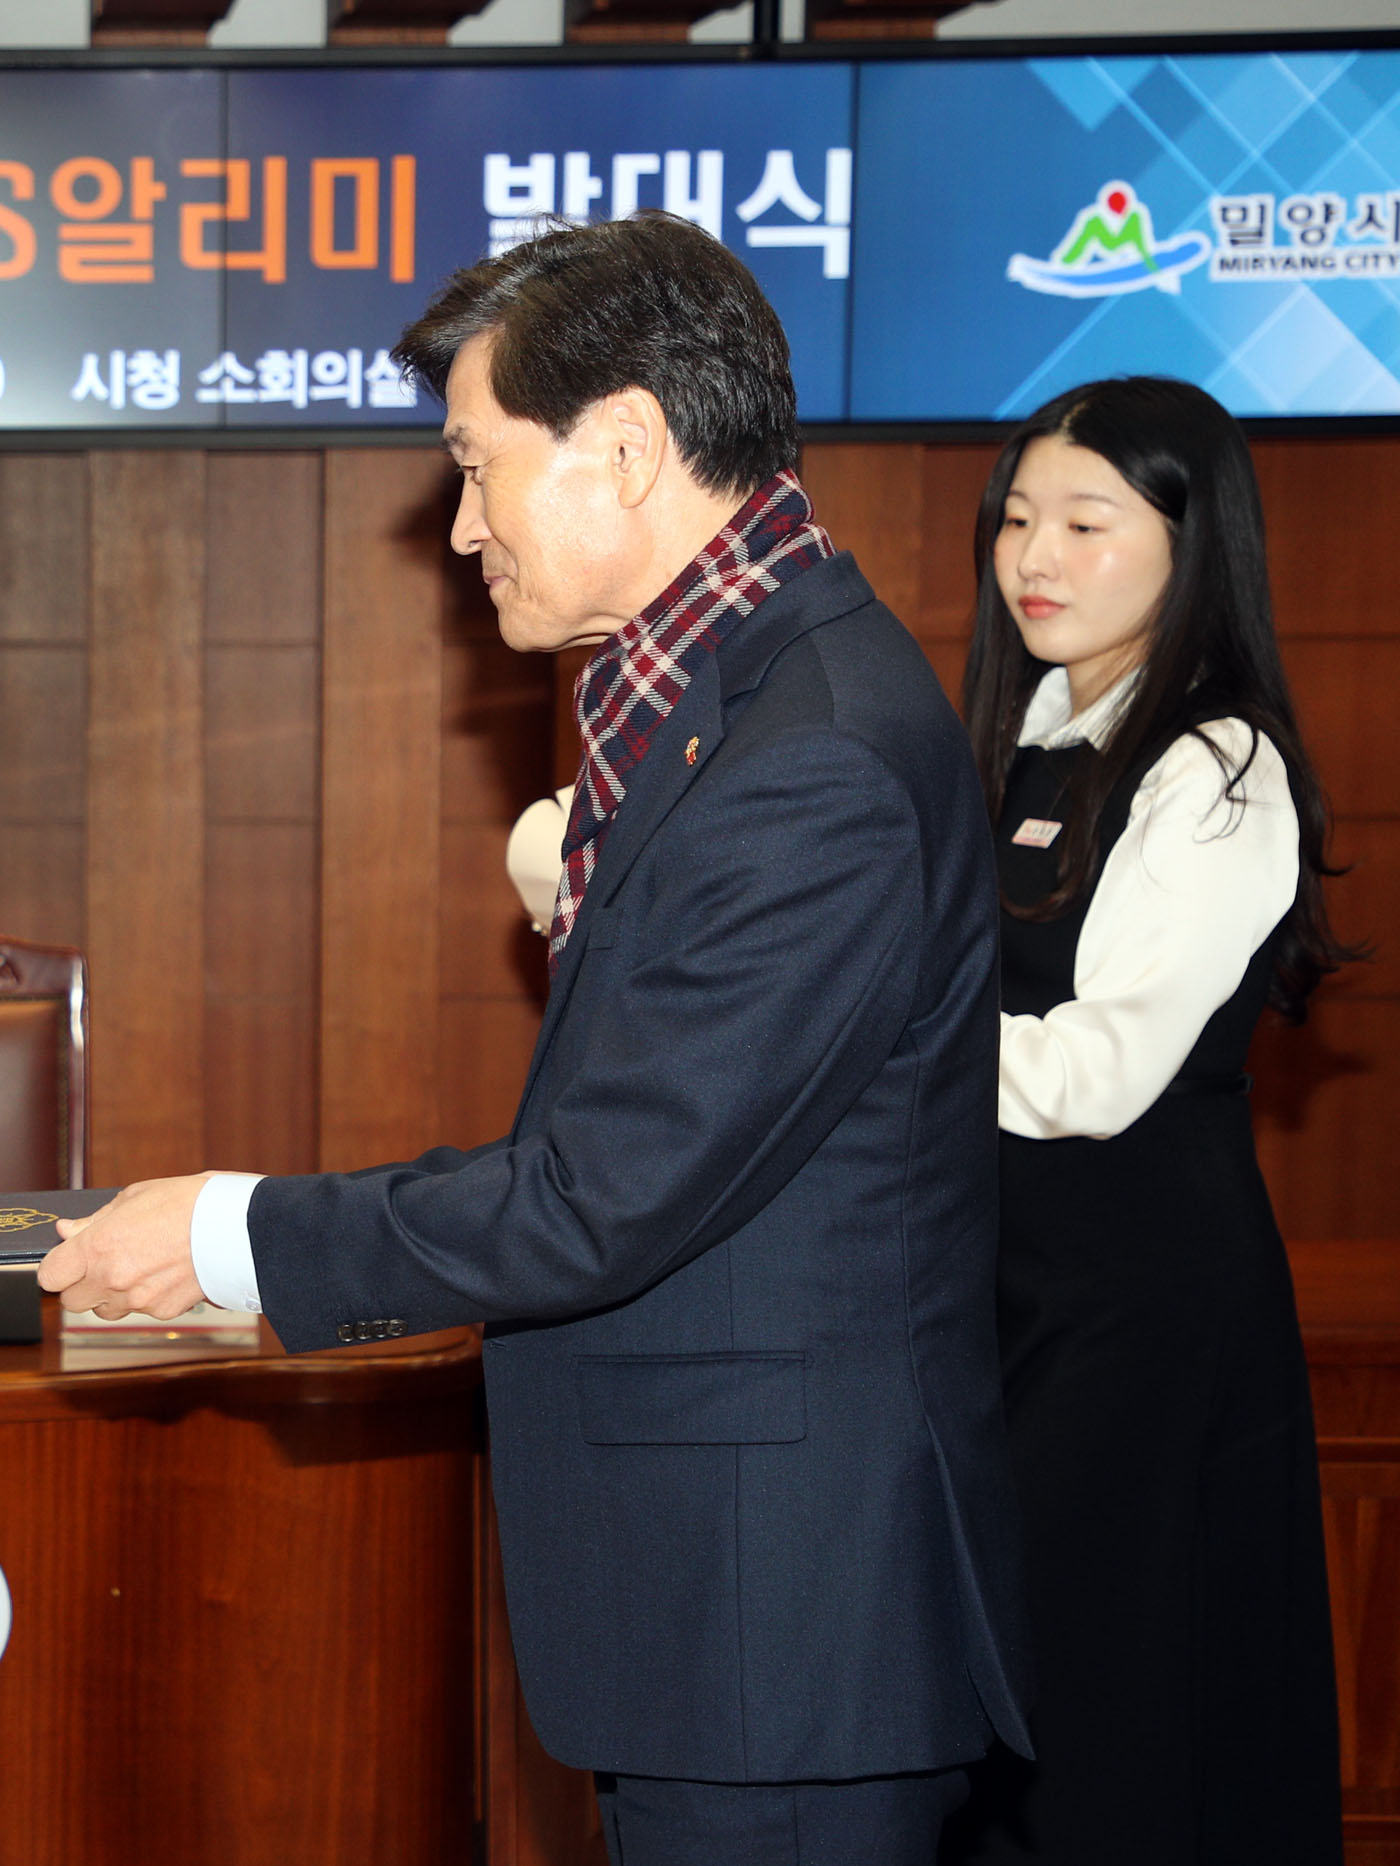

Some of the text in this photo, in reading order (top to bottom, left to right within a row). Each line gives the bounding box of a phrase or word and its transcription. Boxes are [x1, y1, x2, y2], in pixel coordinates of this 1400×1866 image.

[1219, 199, 1400, 247] 밀양시
[1219, 253, 1400, 272] MIRYANG CITY
[70, 349, 181, 410] 시청
[196, 348, 418, 410] 소회의실
